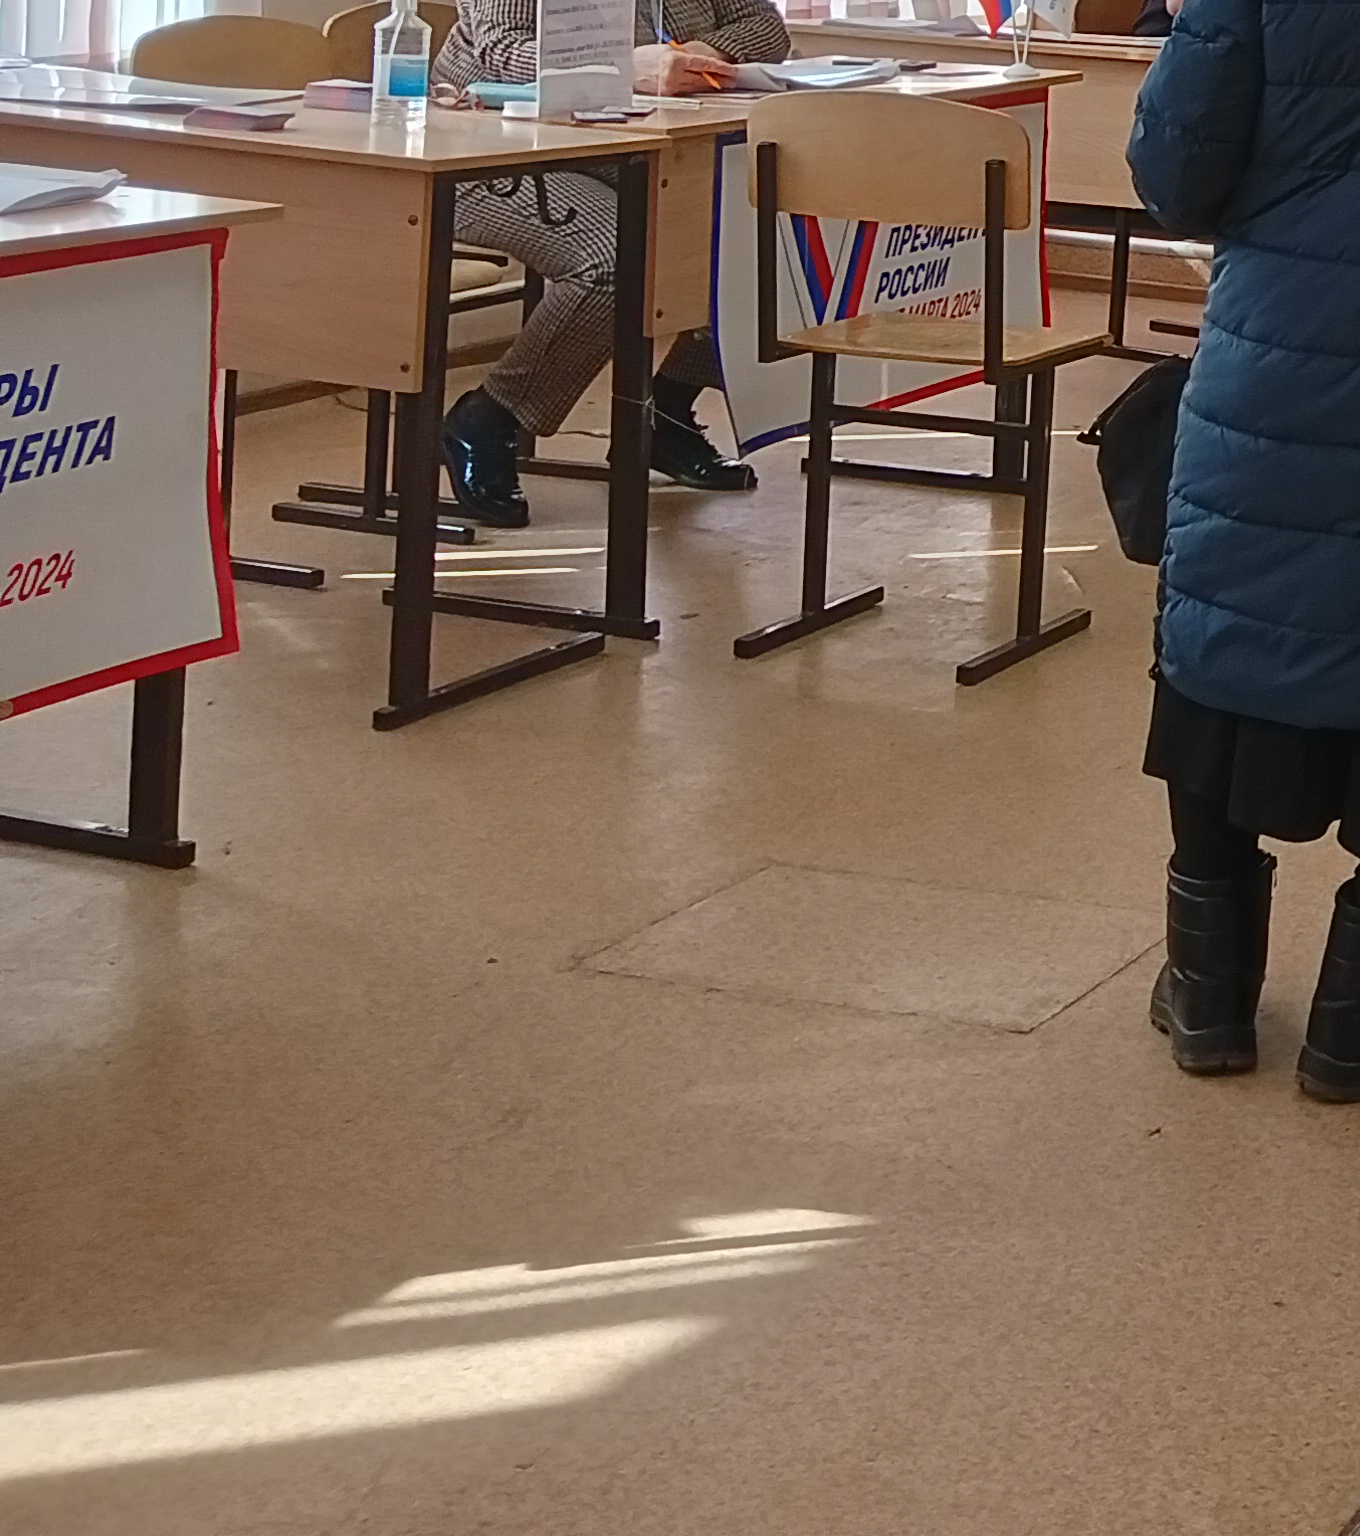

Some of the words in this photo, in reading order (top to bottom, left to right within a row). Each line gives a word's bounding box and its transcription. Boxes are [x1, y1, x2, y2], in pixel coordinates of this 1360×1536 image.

[885, 224, 986, 259] ПРЕЗИДЕ
[874, 256, 951, 304] РОССИИ
[950, 288, 982, 319] 2024
[0, 364, 60, 418] РЫ
[0, 549, 76, 608] 2024
